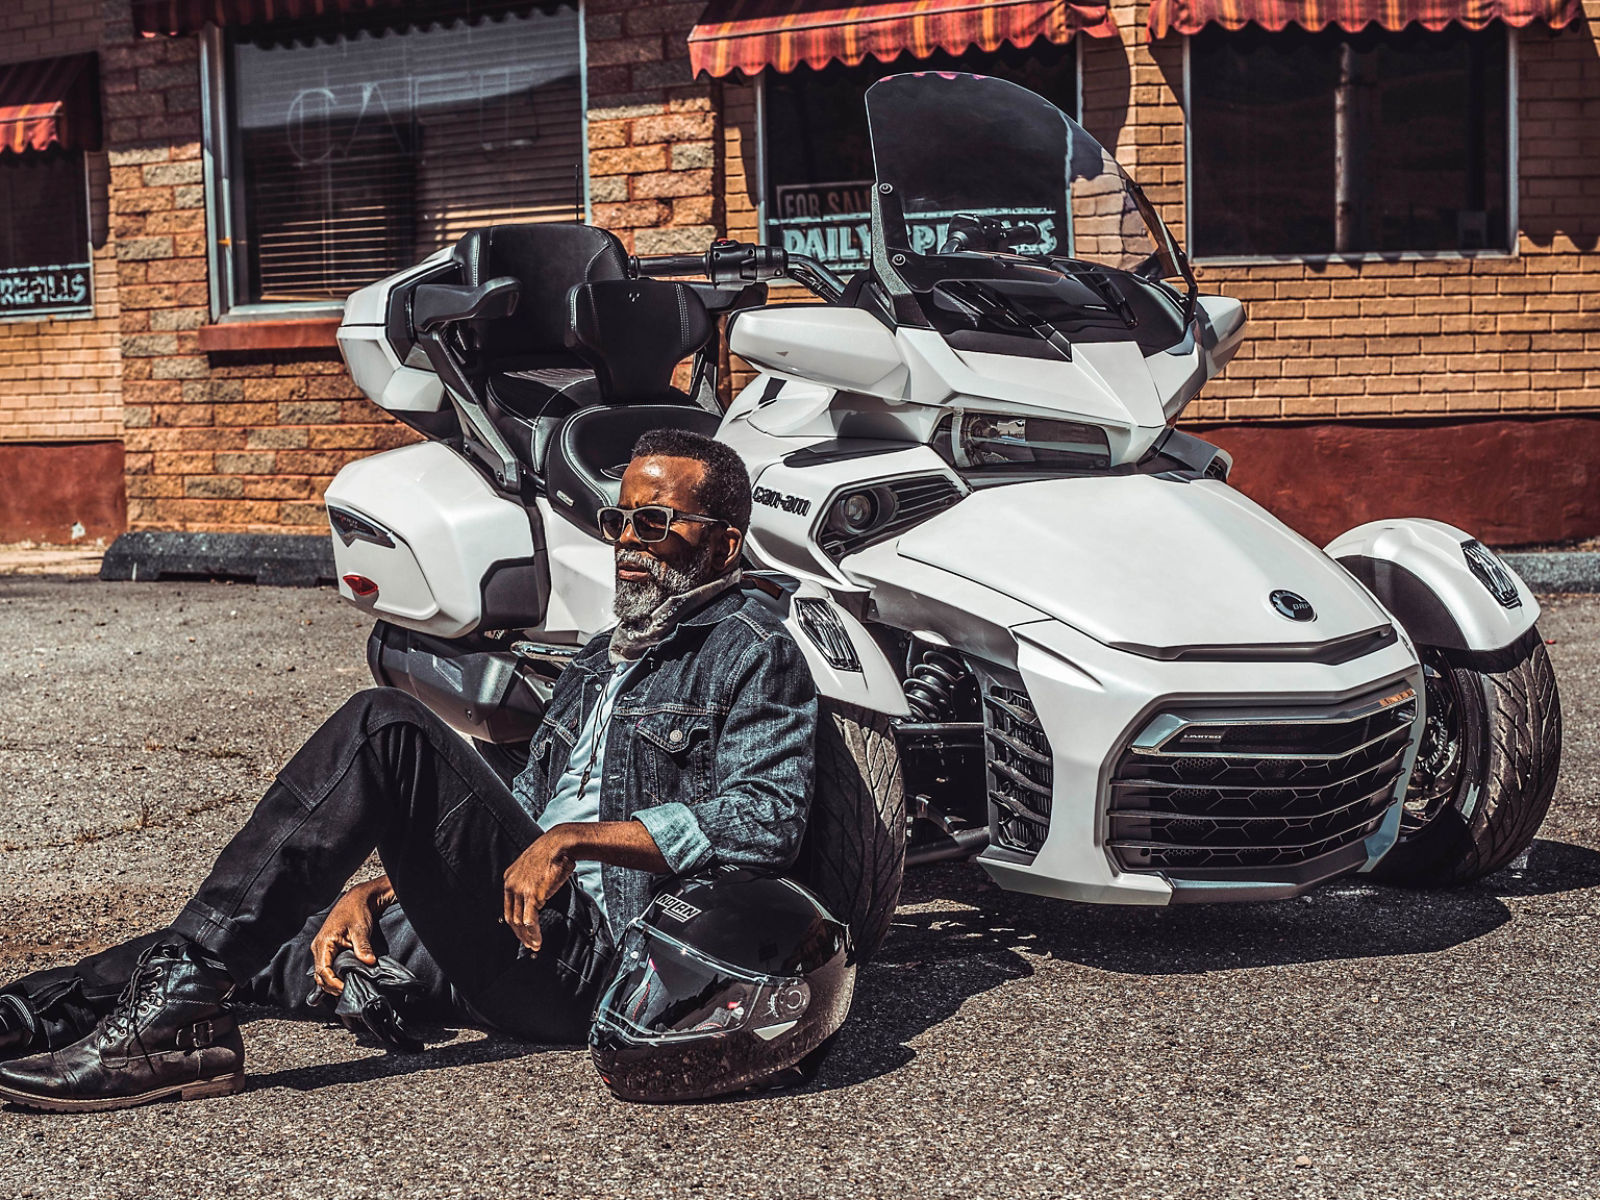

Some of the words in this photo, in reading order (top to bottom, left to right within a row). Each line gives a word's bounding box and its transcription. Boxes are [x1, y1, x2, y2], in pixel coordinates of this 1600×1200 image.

[784, 193, 820, 217] FOR
[782, 223, 871, 262] DAILY
[752, 486, 812, 517] can-am
[656, 893, 700, 919] NOLAN
